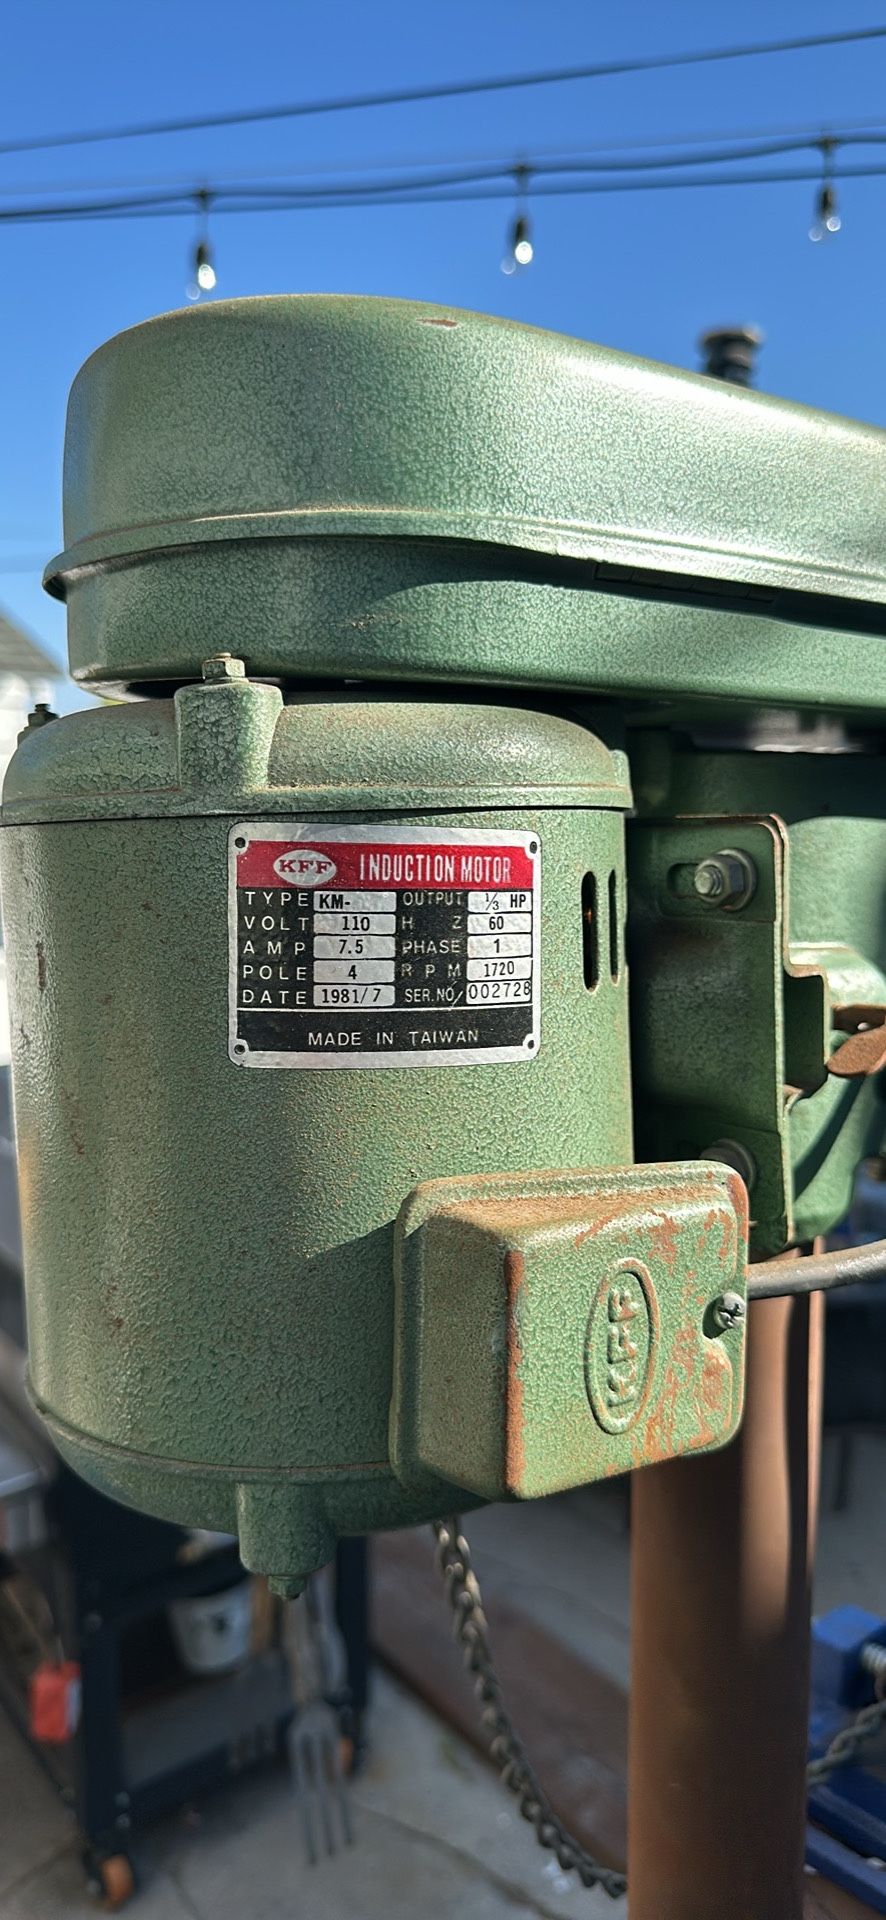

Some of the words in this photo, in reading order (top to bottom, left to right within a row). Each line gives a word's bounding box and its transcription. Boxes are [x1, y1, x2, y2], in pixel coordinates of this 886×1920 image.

[279, 859, 332, 873] KFF
[359, 854, 454, 881] INDUCTION
[461, 858, 511, 882] MOTOR
[246, 892, 308, 906] TYPE
[319, 894, 350, 909] KM-
[403, 892, 462, 905] OUTPUT
[510, 894, 526, 908] HP
[244, 917, 309, 930] VOLT
[342, 916, 370, 930] 110
[489, 917, 504, 930] 60
[243, 942, 305, 955] AMP
[339, 940, 363, 954] 7.5
[402, 940, 460, 954] PHASE
[494, 940, 500, 953] 1
[243, 966, 306, 979] POLE
[348, 965, 357, 979] 4
[483, 962, 514, 976] 1720
[243, 990, 306, 1004] DATE
[469, 981, 531, 999] 002728
[308, 1032, 361, 1045] MADE
[377, 1033, 393, 1044] IN
[409, 1031, 478, 1043] TAIWAN
[608, 1287, 640, 1407] KFF
